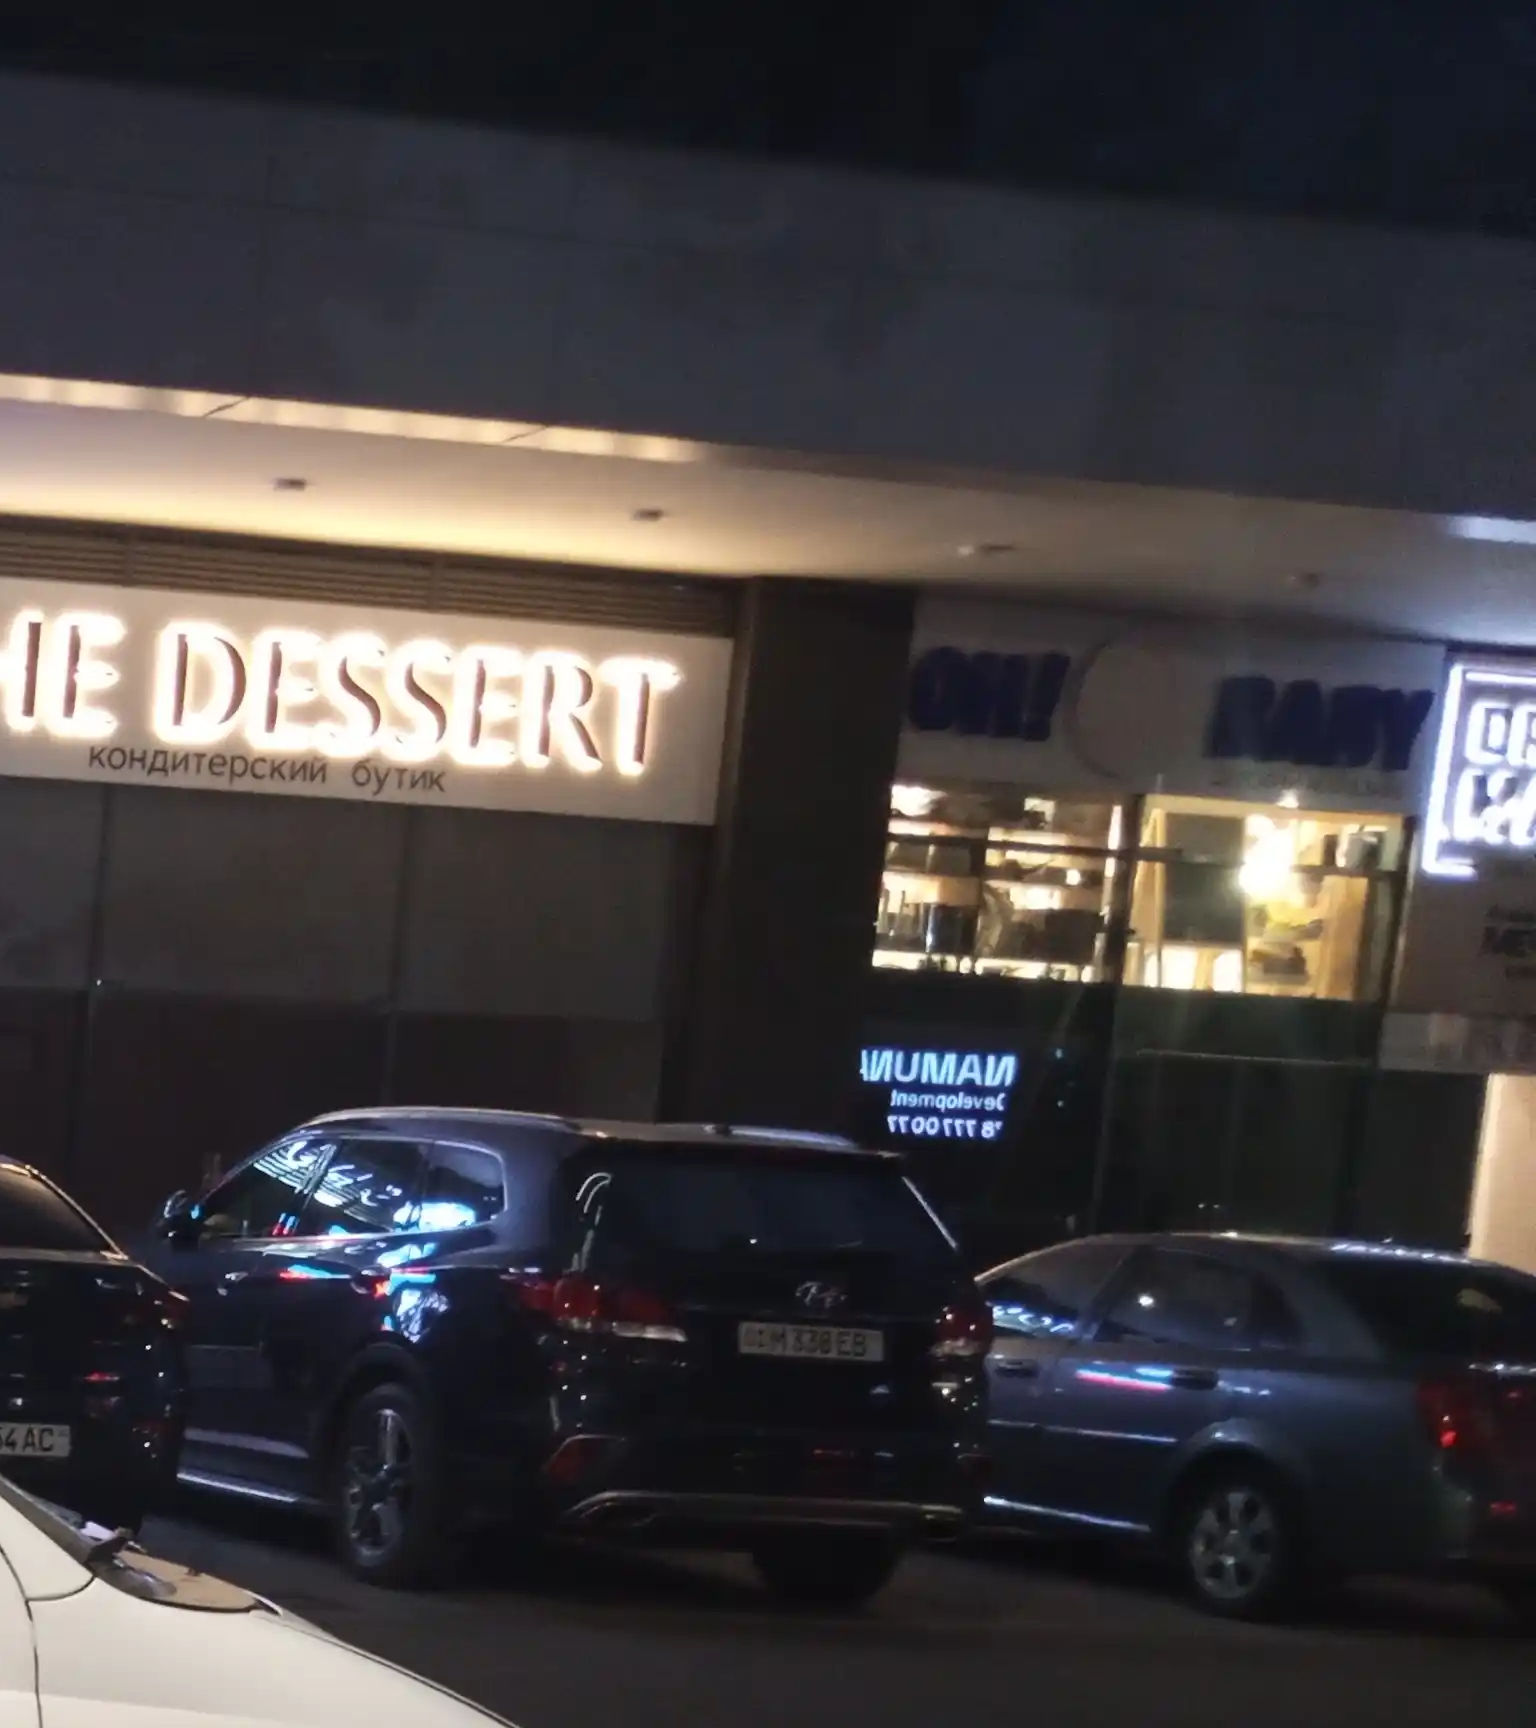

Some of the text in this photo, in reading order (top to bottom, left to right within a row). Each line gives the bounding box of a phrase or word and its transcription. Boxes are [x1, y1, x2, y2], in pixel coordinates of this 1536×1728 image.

[154, 620, 680, 772] DESSERT
[88, 746, 447, 796] кондитерский бутик
